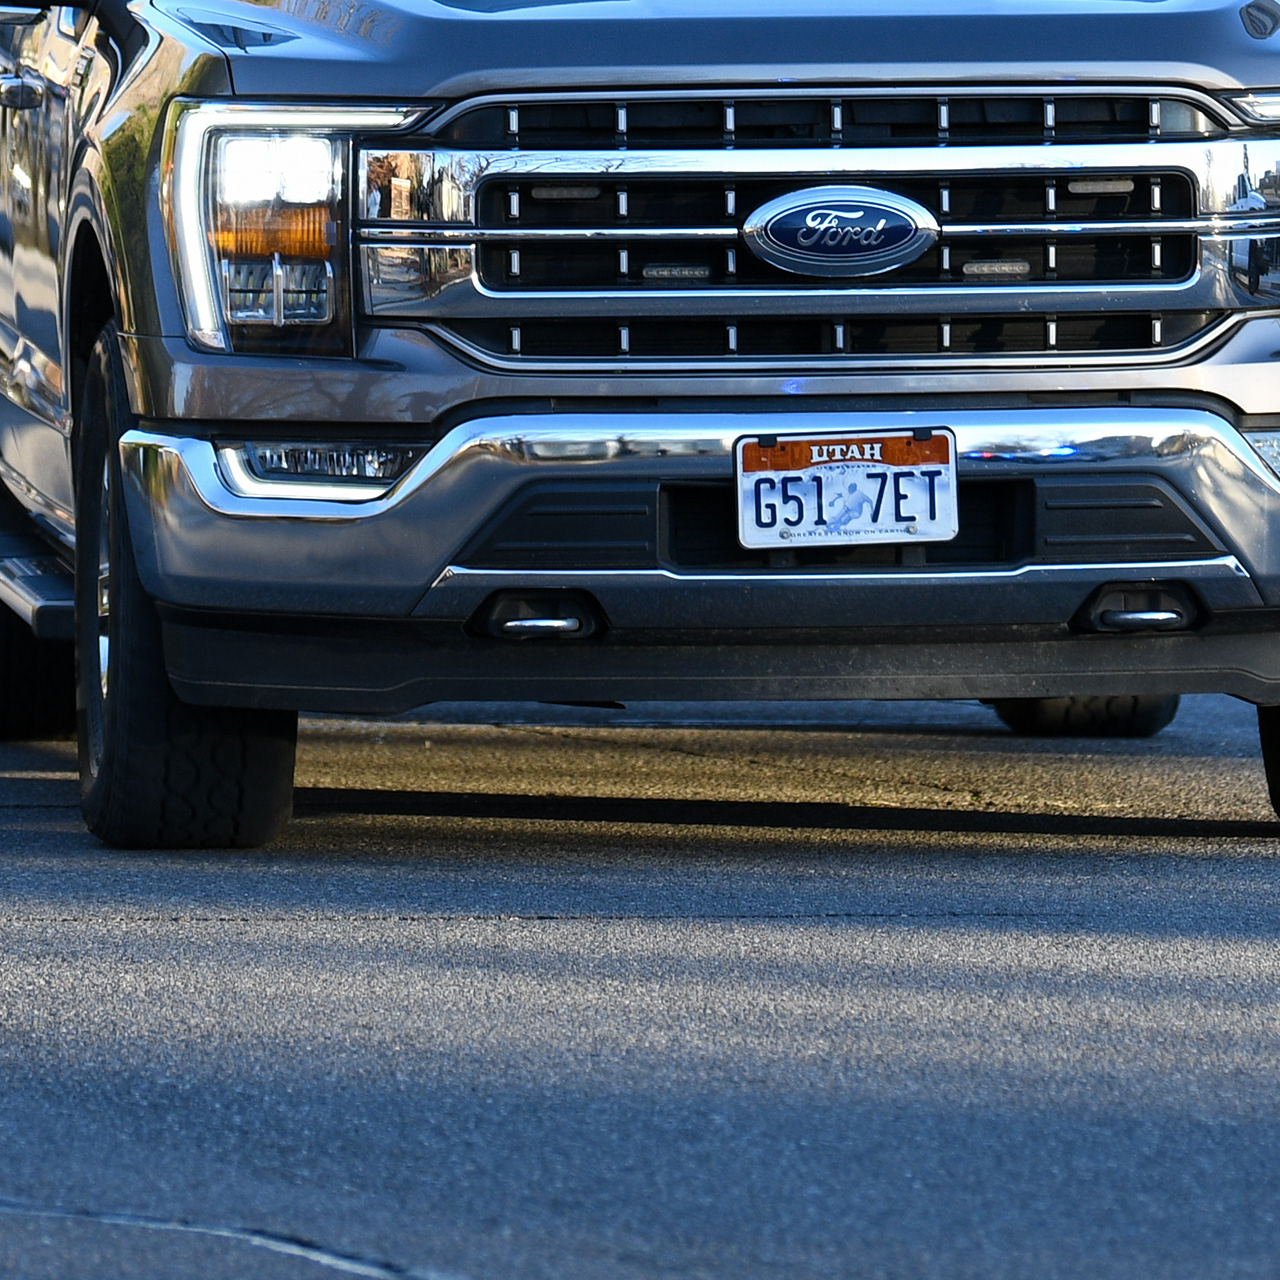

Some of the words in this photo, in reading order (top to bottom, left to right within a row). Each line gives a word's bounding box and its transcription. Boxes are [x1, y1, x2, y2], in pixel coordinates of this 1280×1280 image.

[797, 208, 887, 247] Ford
[810, 443, 883, 463] UTAH
[789, 528, 834, 538] GREATEST
[837, 529, 860, 537] SNOW
[879, 527, 907, 535] EARTH
